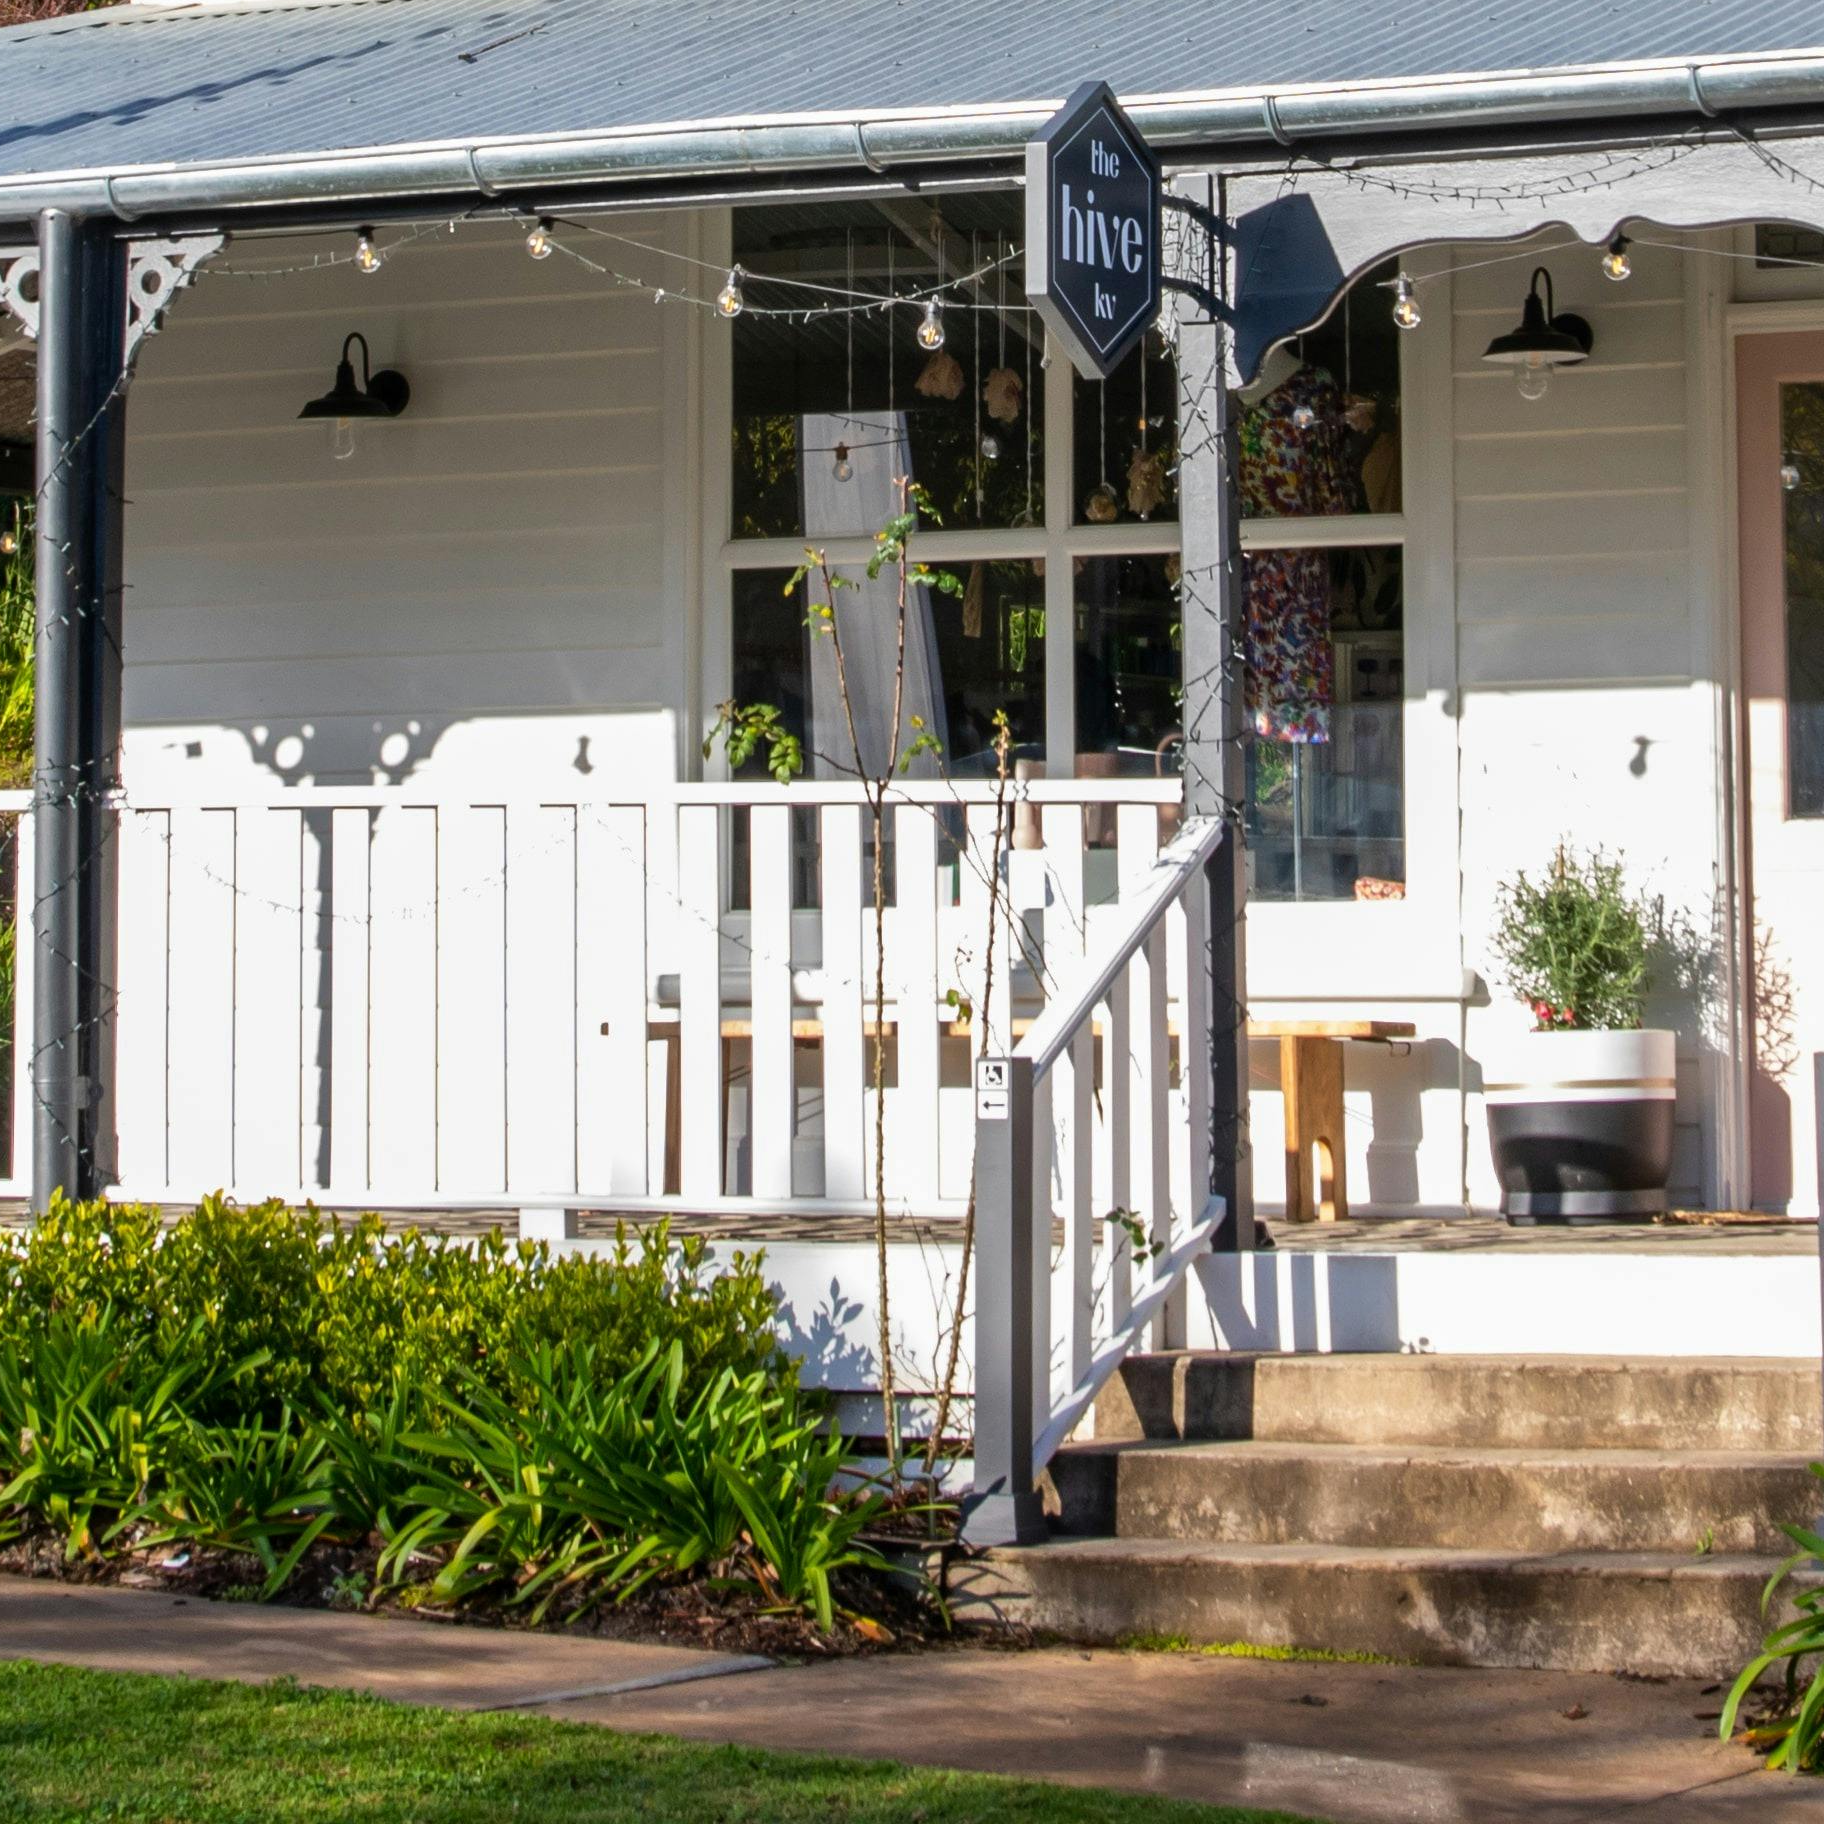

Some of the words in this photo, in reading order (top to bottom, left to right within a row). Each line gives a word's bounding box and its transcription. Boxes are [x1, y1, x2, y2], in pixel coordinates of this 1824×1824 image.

[1091, 140, 1120, 178] the
[1062, 184, 1143, 274] hive
[1094, 283, 1117, 320] kv
